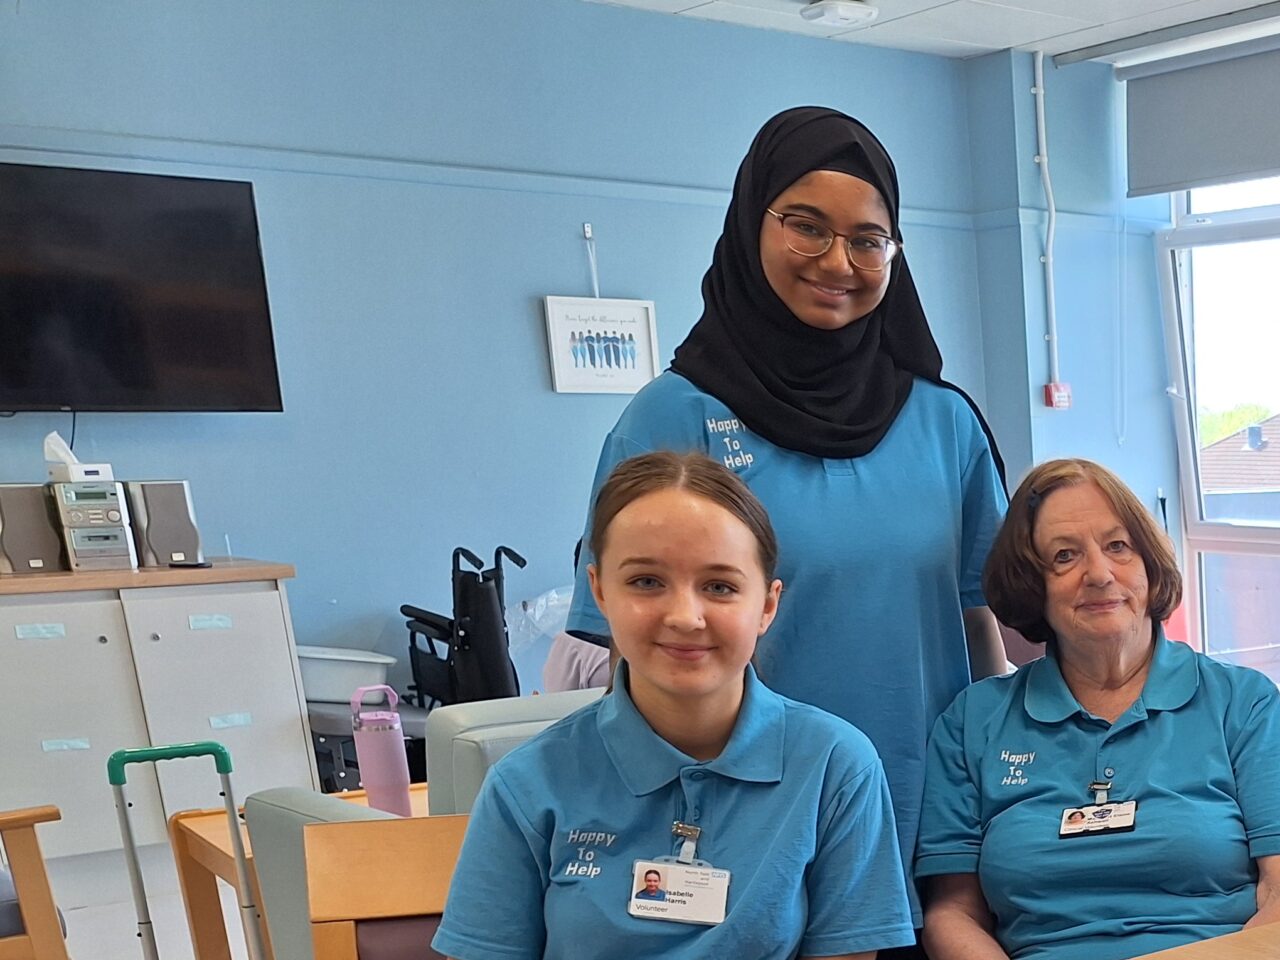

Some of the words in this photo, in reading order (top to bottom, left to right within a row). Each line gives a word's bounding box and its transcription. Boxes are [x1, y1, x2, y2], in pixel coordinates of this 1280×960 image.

[723, 437, 740, 452] To
[723, 450, 754, 469] Help
[1000, 750, 1036, 765] Happy
[1009, 766, 1023, 777] To
[1001, 776, 1029, 786] Help
[567, 830, 617, 847] Happy
[577, 847, 595, 861] To
[565, 862, 601, 878] Help
